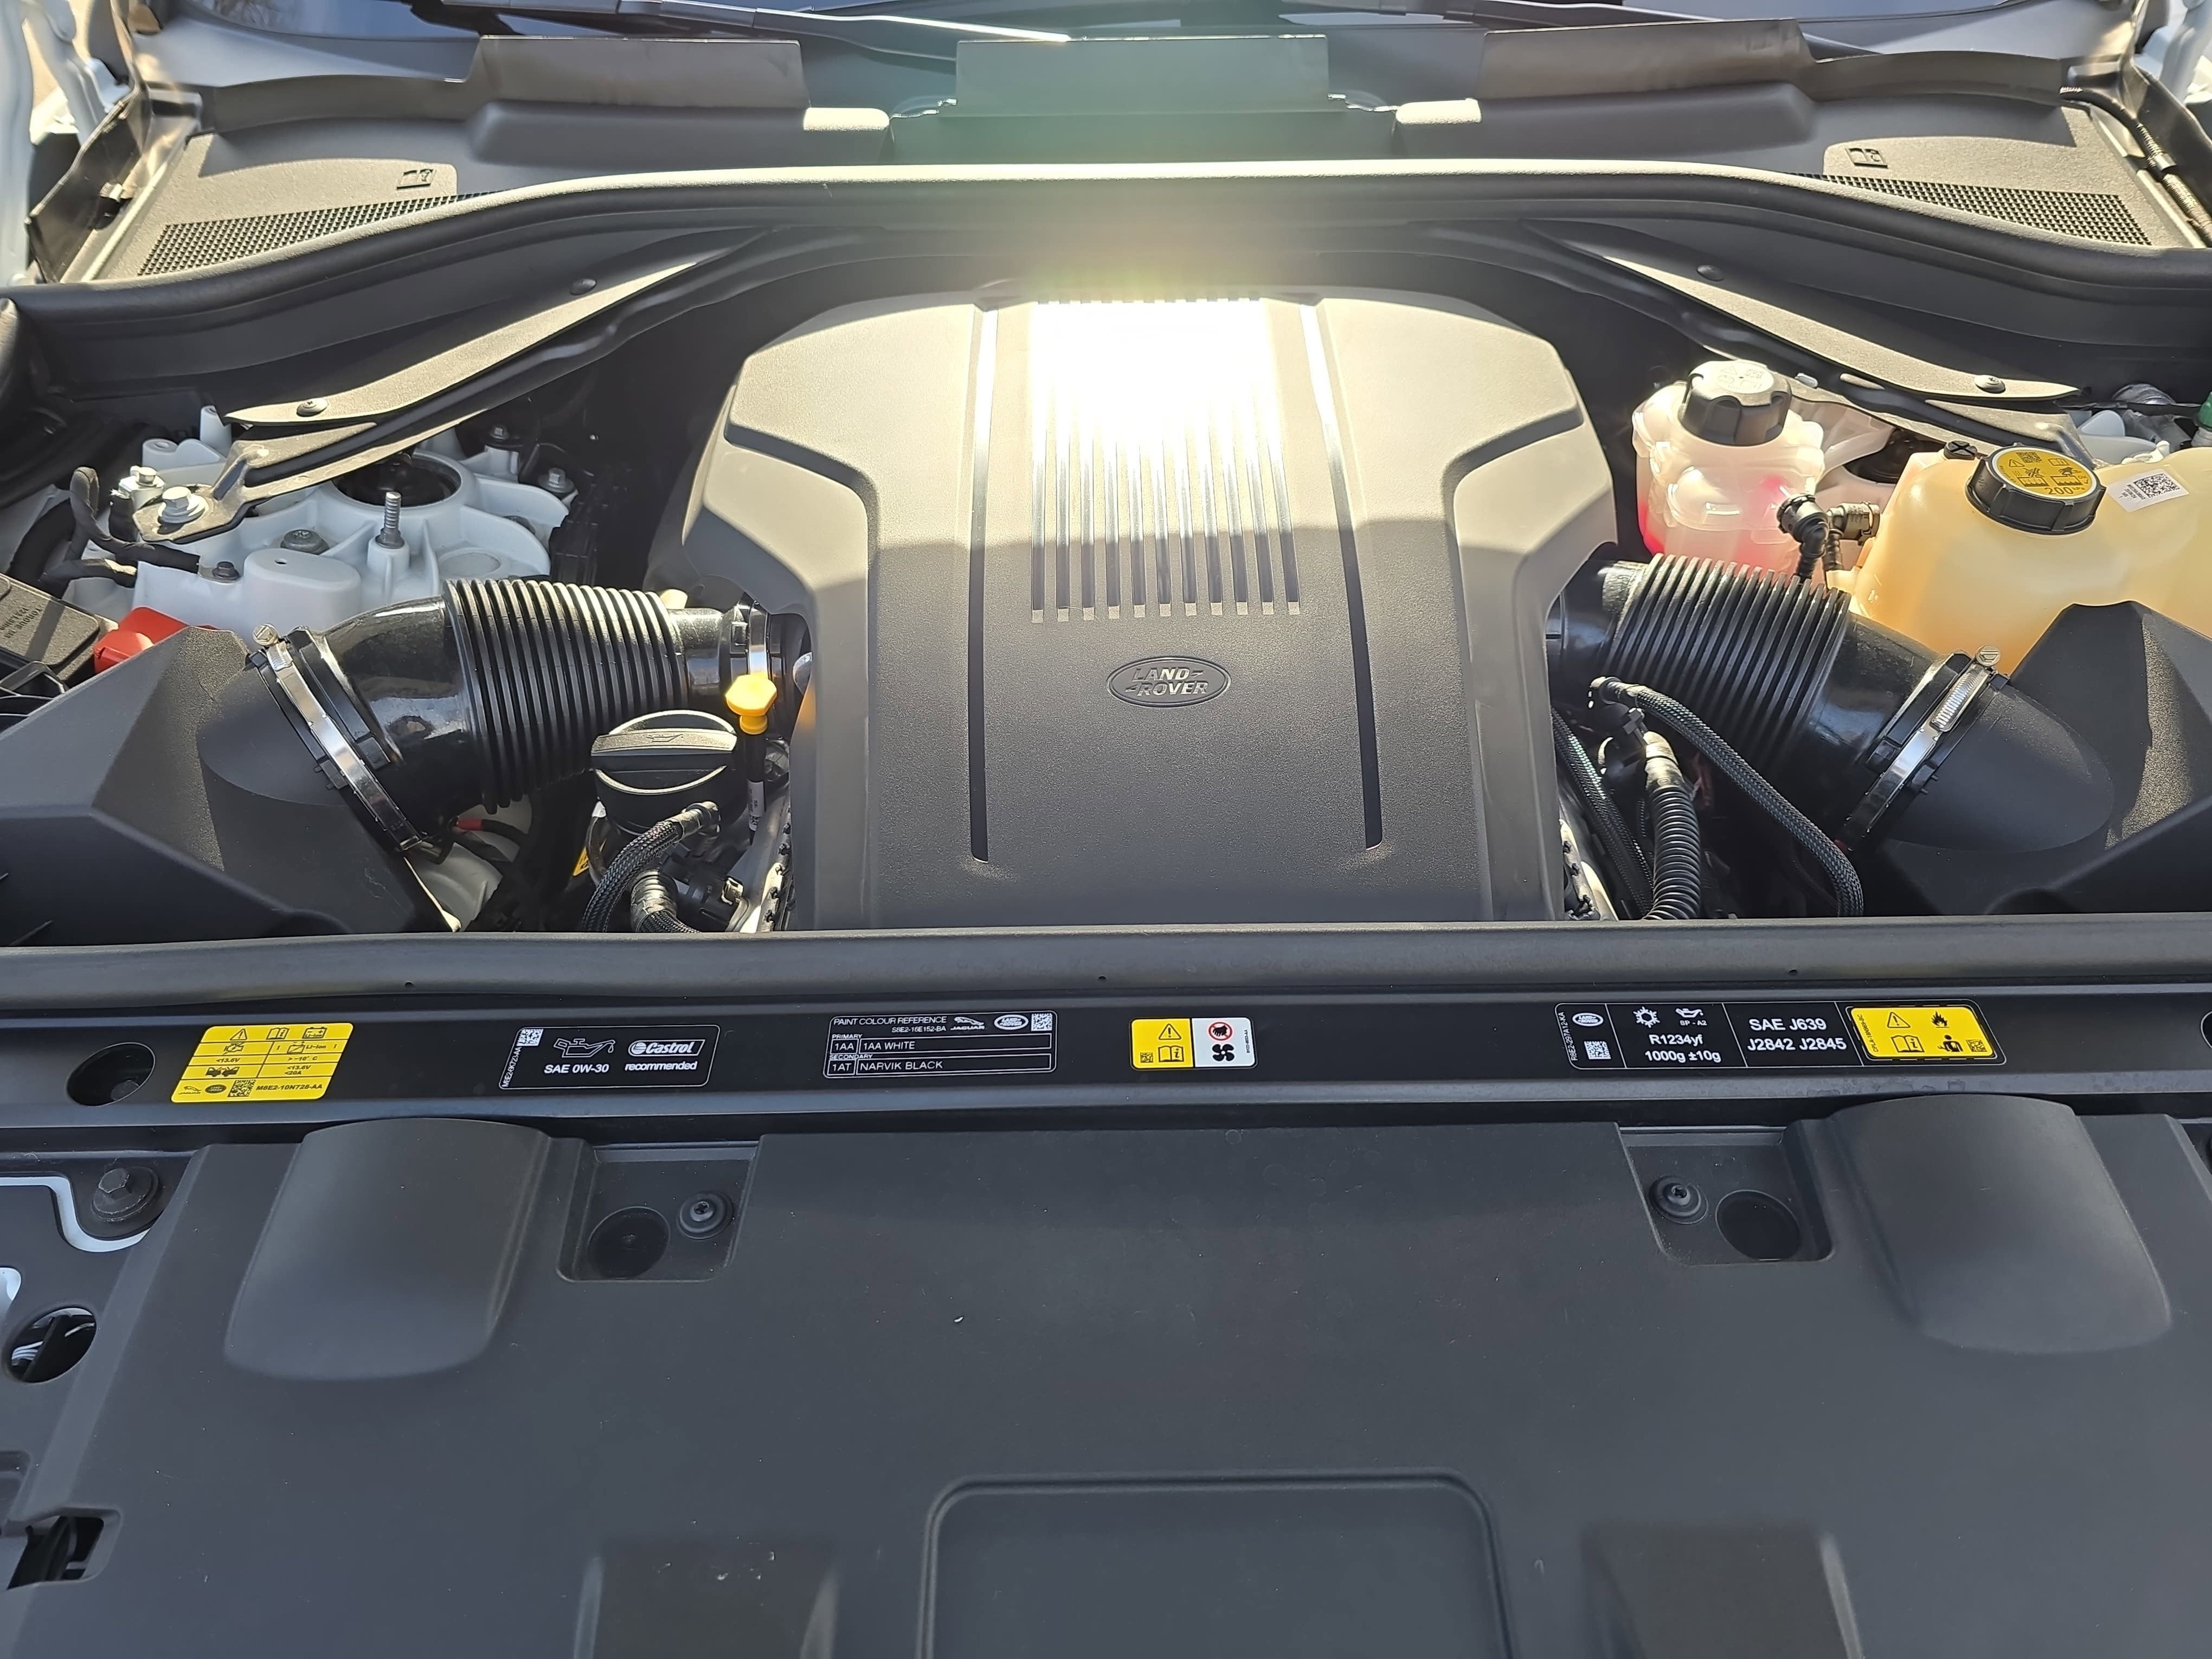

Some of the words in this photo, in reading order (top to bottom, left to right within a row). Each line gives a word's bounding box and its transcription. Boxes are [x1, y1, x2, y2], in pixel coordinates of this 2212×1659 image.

[2044, 486, 2074, 496] 200
[1131, 667, 1190, 683] LAND
[1137, 681, 1210, 697] ROVER
[833, 1018, 858, 1026] PAINT
[859, 1017, 896, 1025] COLOUR
[898, 1016, 947, 1024] REFERENCE
[1749, 1018, 1786, 1031] SAE
[1789, 1018, 1827, 1031] J639
[1559, 1011, 1578, 1061] R8E2-297A12-KA
[1648, 1034, 1703, 1046] R1234yf
[645, 1041, 693, 1054] Castrol
[834, 1043, 855, 1051] 1AA
[863, 1042, 883, 1050] 1AA
[884, 1041, 916, 1050] WHITE
[1747, 1038, 1796, 1051] J2842
[1798, 1037, 1847, 1051] J2845
[1644, 1050, 1687, 1063] 1000g
[1688, 1050, 1722, 1063] ±10g
[544, 1064, 570, 1073] SAE
[572, 1063, 610, 1073] 0W-30
[625, 1060, 698, 1071] recommended
[832, 1063, 852, 1071] 1AT
[860, 1061, 902, 1071] NARVIK
[905, 1060, 944, 1070] BLACK
